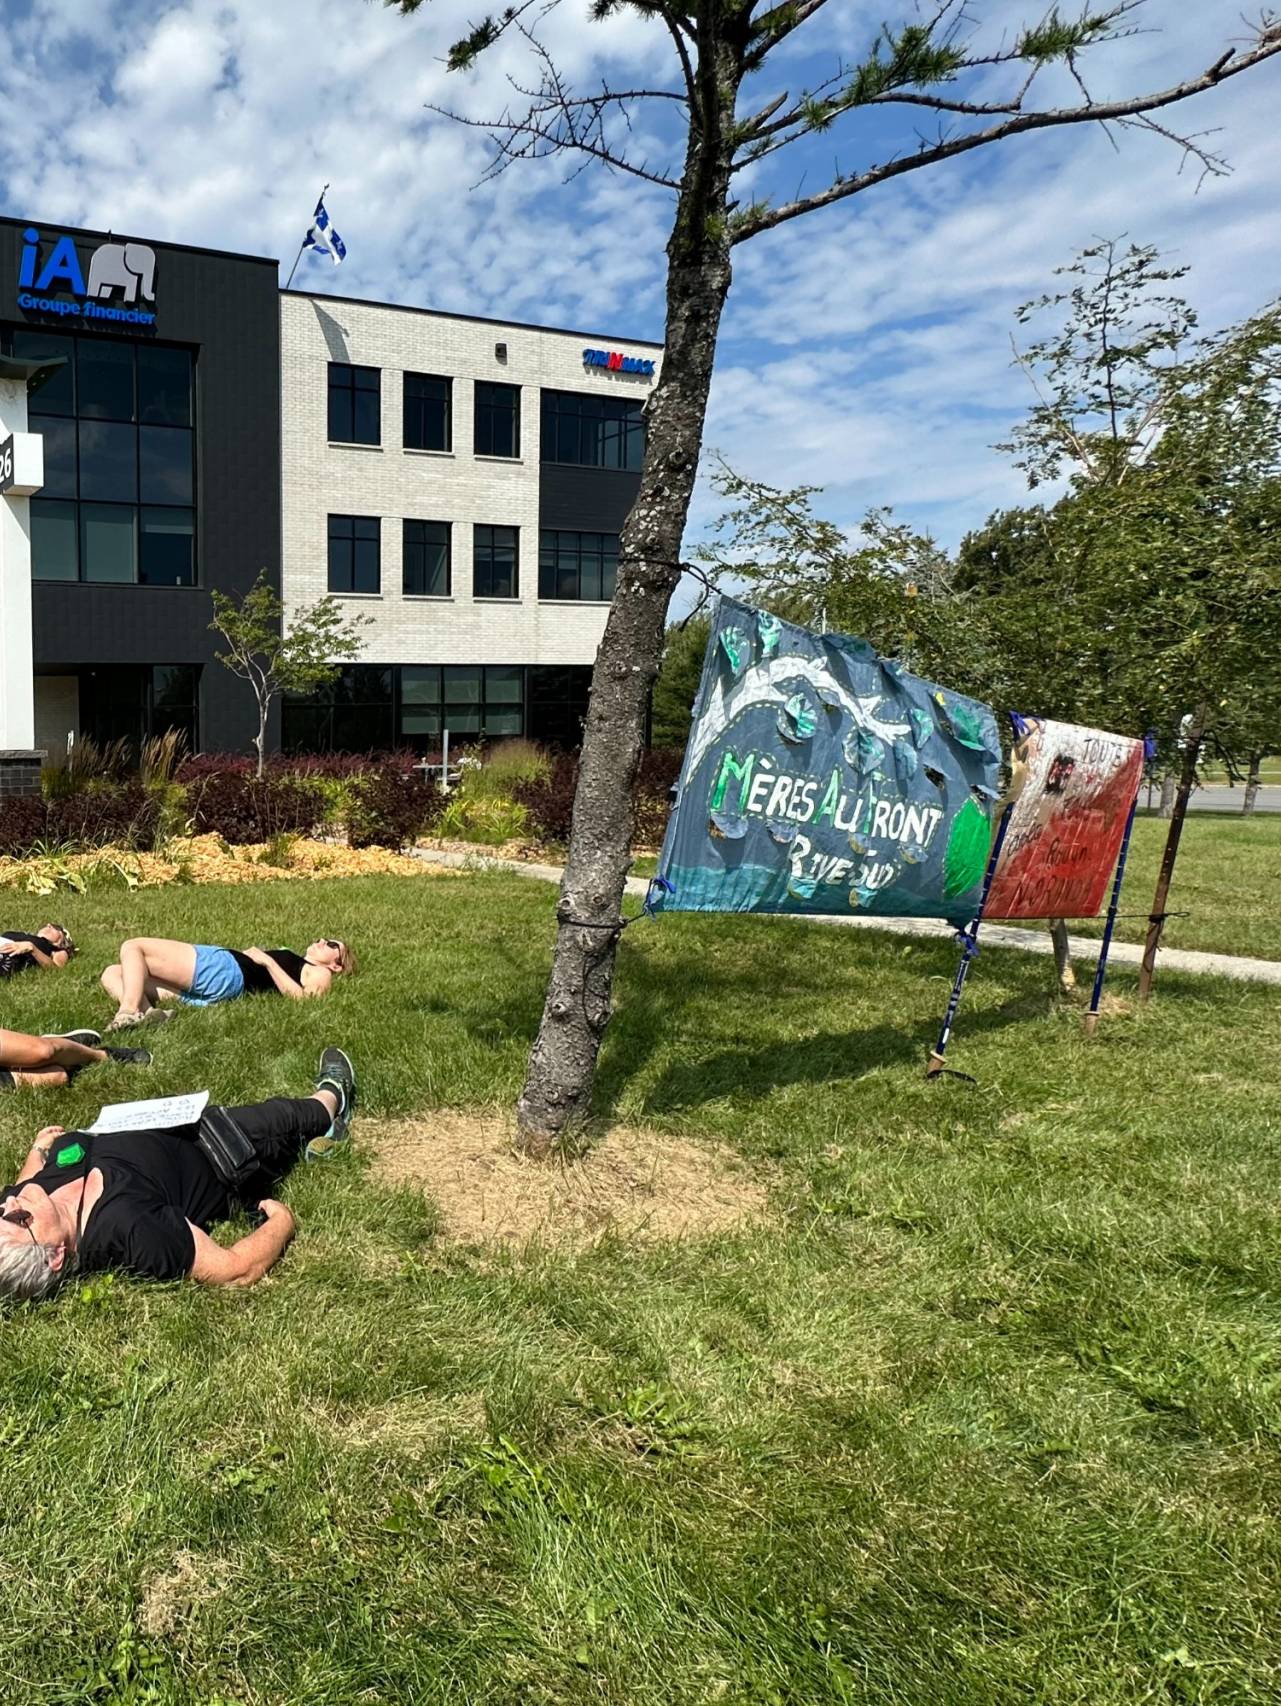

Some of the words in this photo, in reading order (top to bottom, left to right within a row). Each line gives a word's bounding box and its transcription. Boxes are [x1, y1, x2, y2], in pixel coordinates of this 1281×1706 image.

[19, 227, 88, 296] iA
[18, 294, 80, 317] Groupe
[83, 302, 156, 325] financier
[813, 769, 863, 833] AU
[862, 772, 943, 848] FRONT
